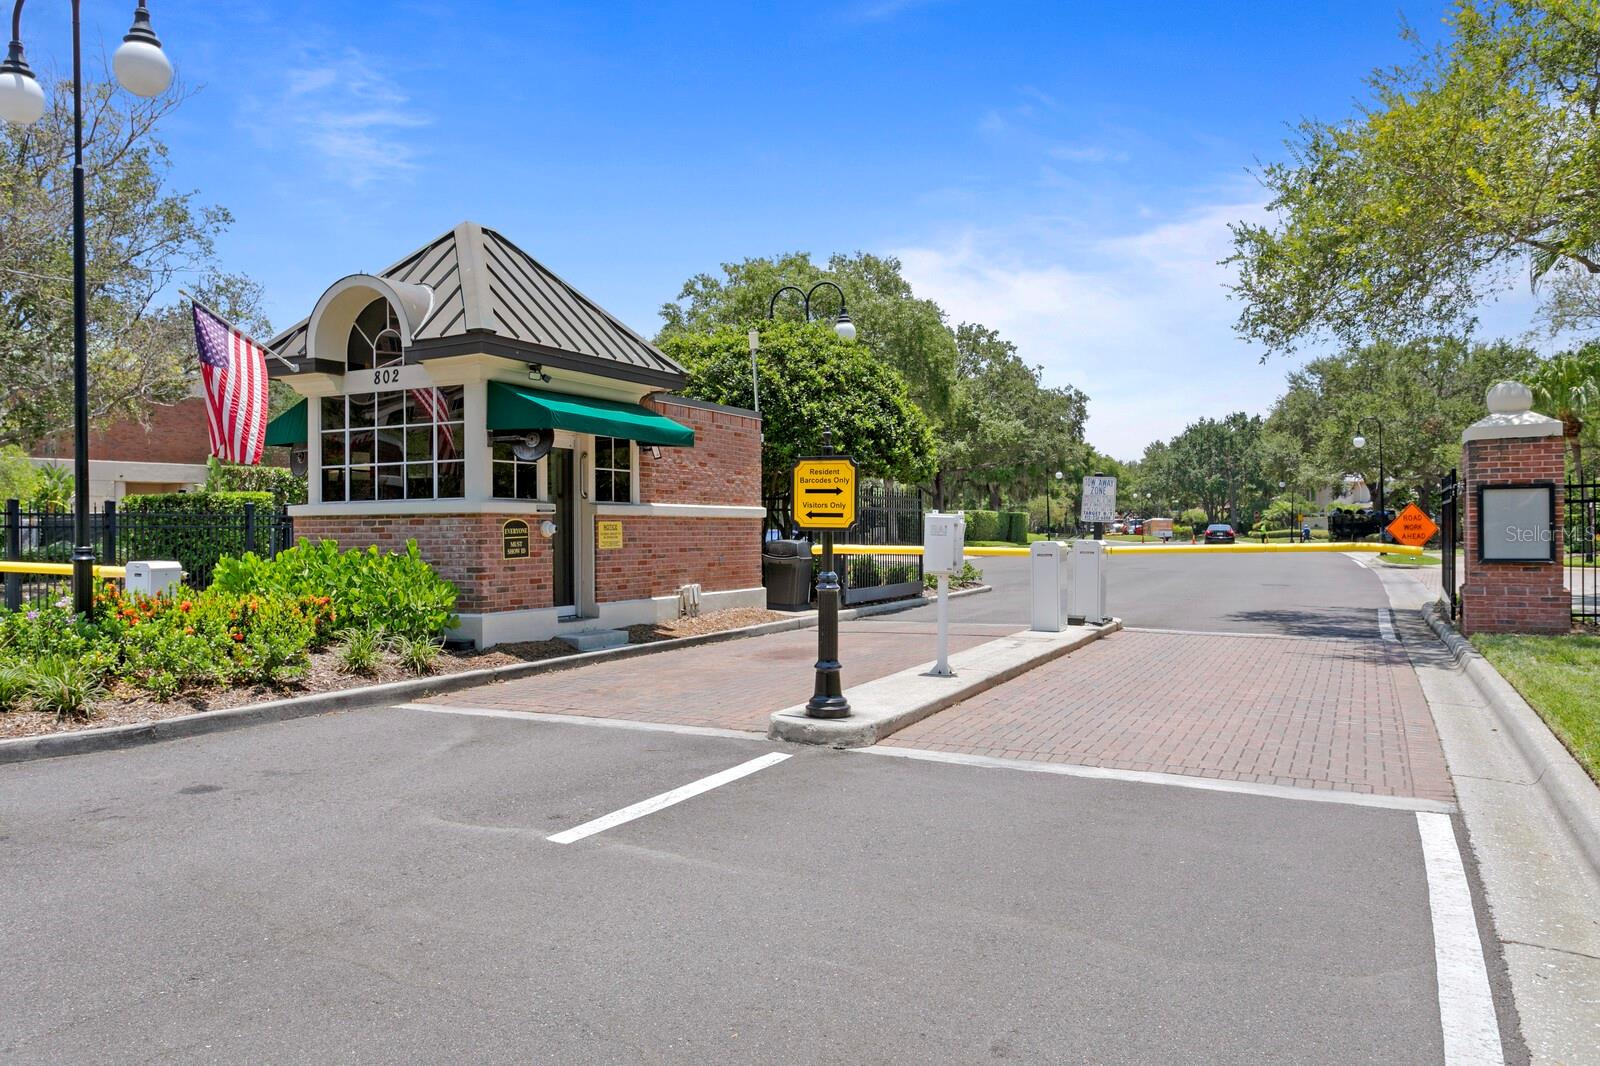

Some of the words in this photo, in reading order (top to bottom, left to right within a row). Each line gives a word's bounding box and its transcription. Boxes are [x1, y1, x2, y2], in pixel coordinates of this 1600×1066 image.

[374, 369, 399, 384] 802
[833, 477, 850, 485] Only
[1090, 487, 1106, 495] ZONE
[830, 502, 846, 510] Only
